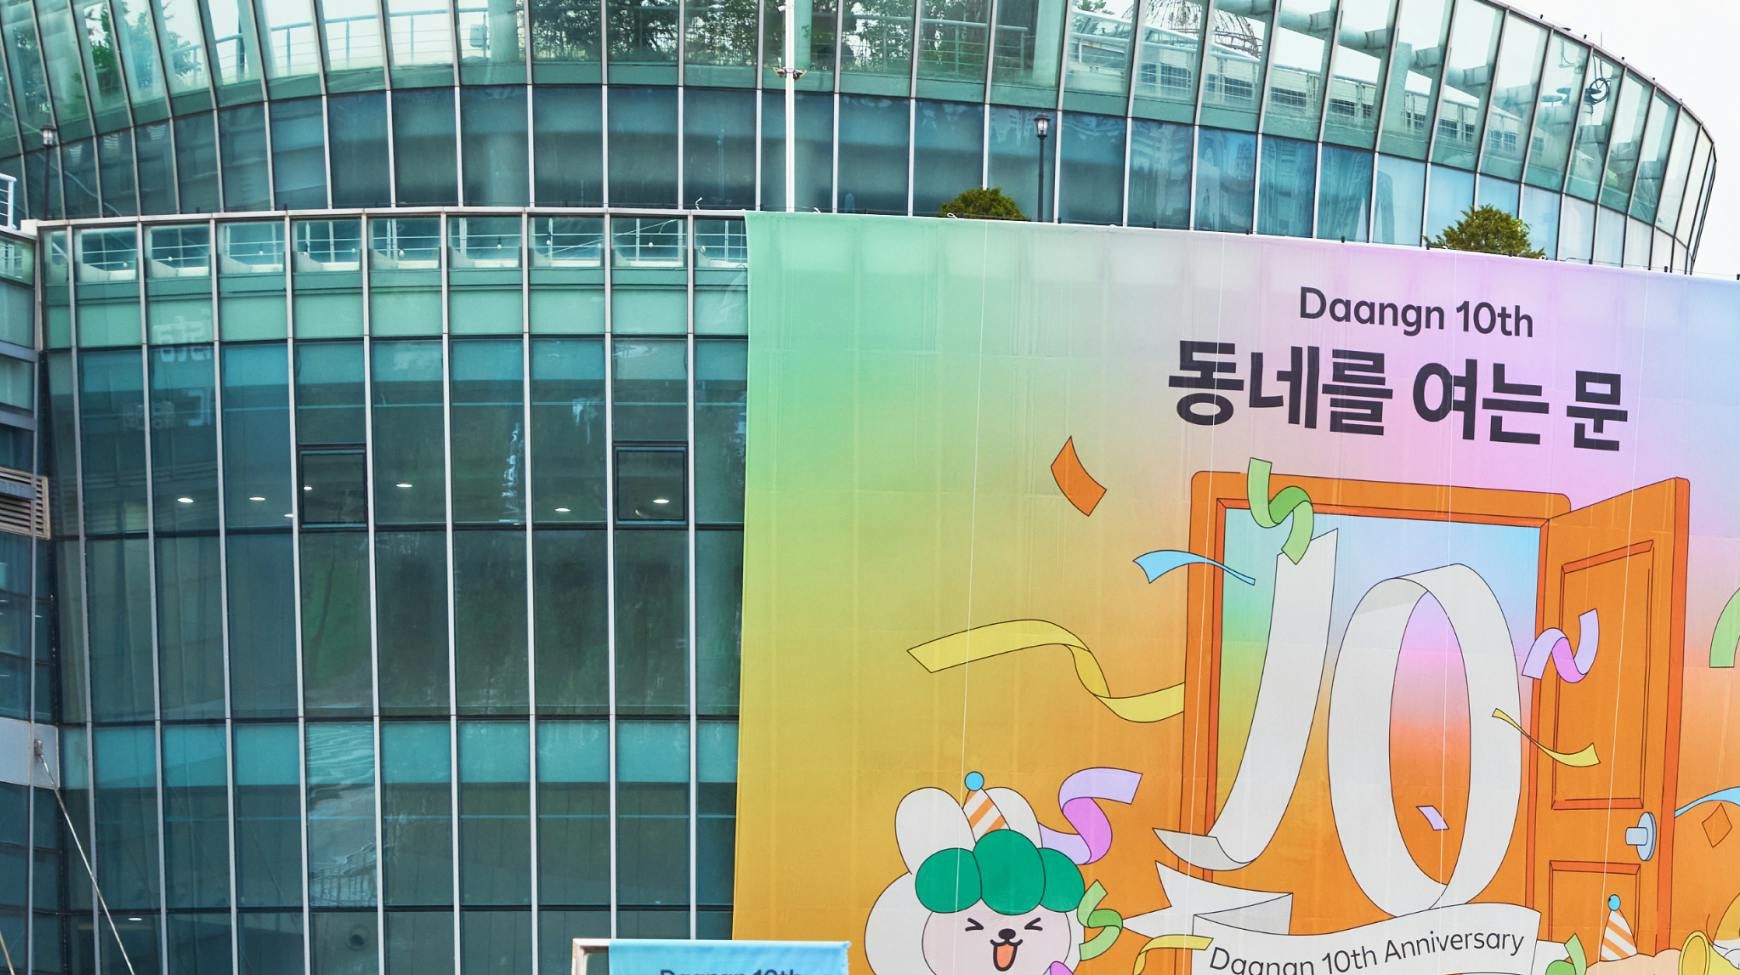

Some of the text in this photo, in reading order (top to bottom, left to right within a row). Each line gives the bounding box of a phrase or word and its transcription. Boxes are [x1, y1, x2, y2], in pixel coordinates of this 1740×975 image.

[1299, 286, 1534, 338] Daangn 10th
[1168, 340, 1628, 452] 동네를 여는 문
[1322, 945, 1378, 974] 10th
[1384, 929, 1525, 963] Anniversary
